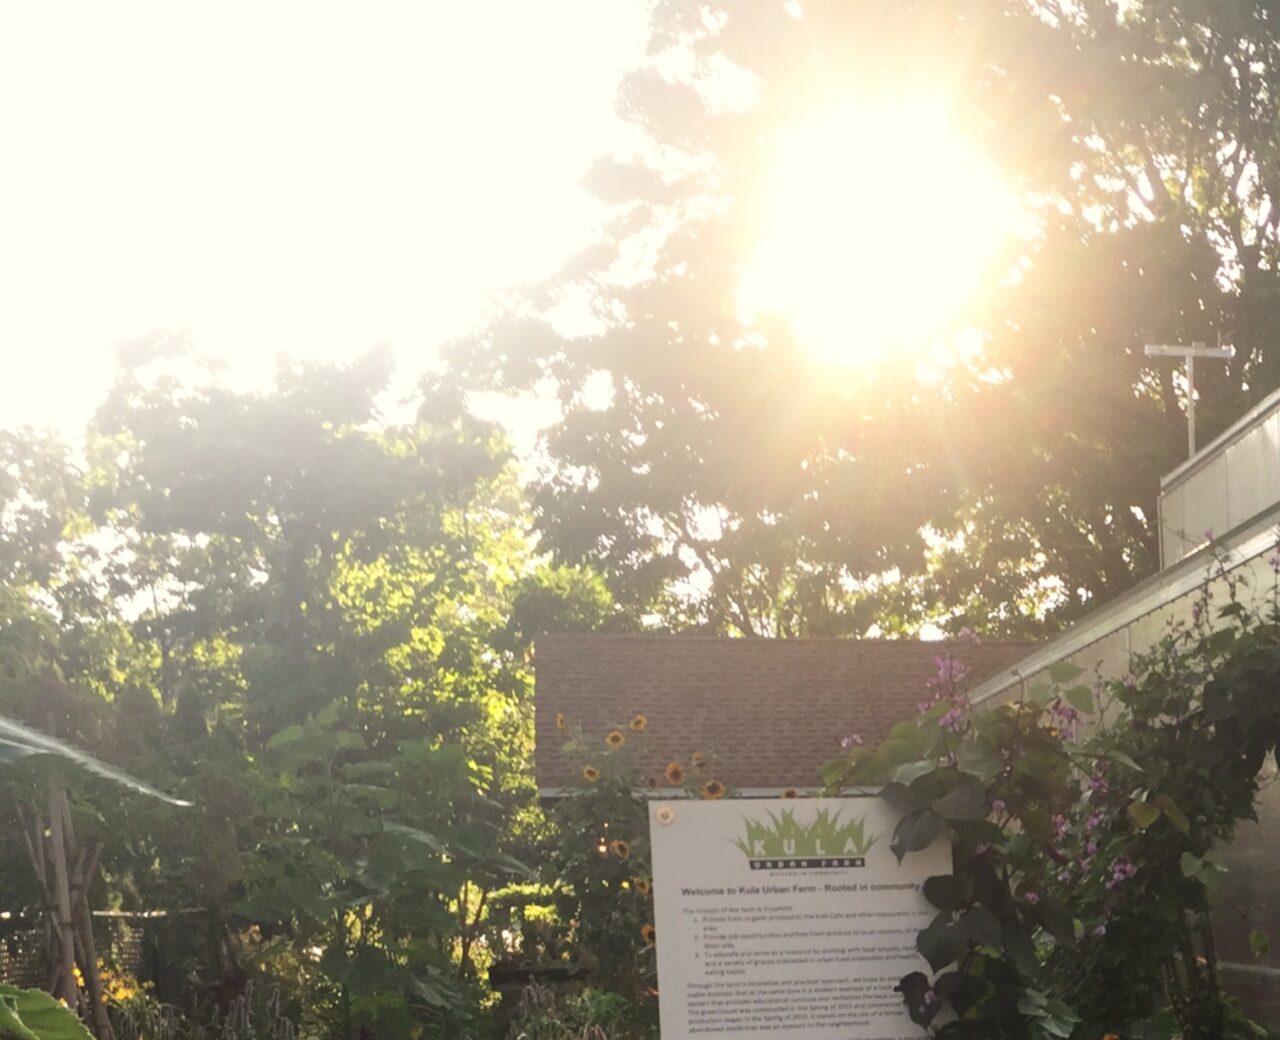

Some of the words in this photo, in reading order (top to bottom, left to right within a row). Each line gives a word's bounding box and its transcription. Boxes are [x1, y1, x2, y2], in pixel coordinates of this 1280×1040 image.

[754, 838, 858, 856] KULA
[754, 860, 808, 869] URBAN
[821, 859, 863, 867] FARM
[681, 887, 724, 896] Welcome
[726, 887, 736, 895] to
[738, 886, 759, 894] Kula
[761, 885, 790, 894] Urban
[792, 884, 816, 893] Farm
[824, 883, 857, 892] Rooted
[858, 883, 868, 891] in
[869, 883, 919, 893] community
